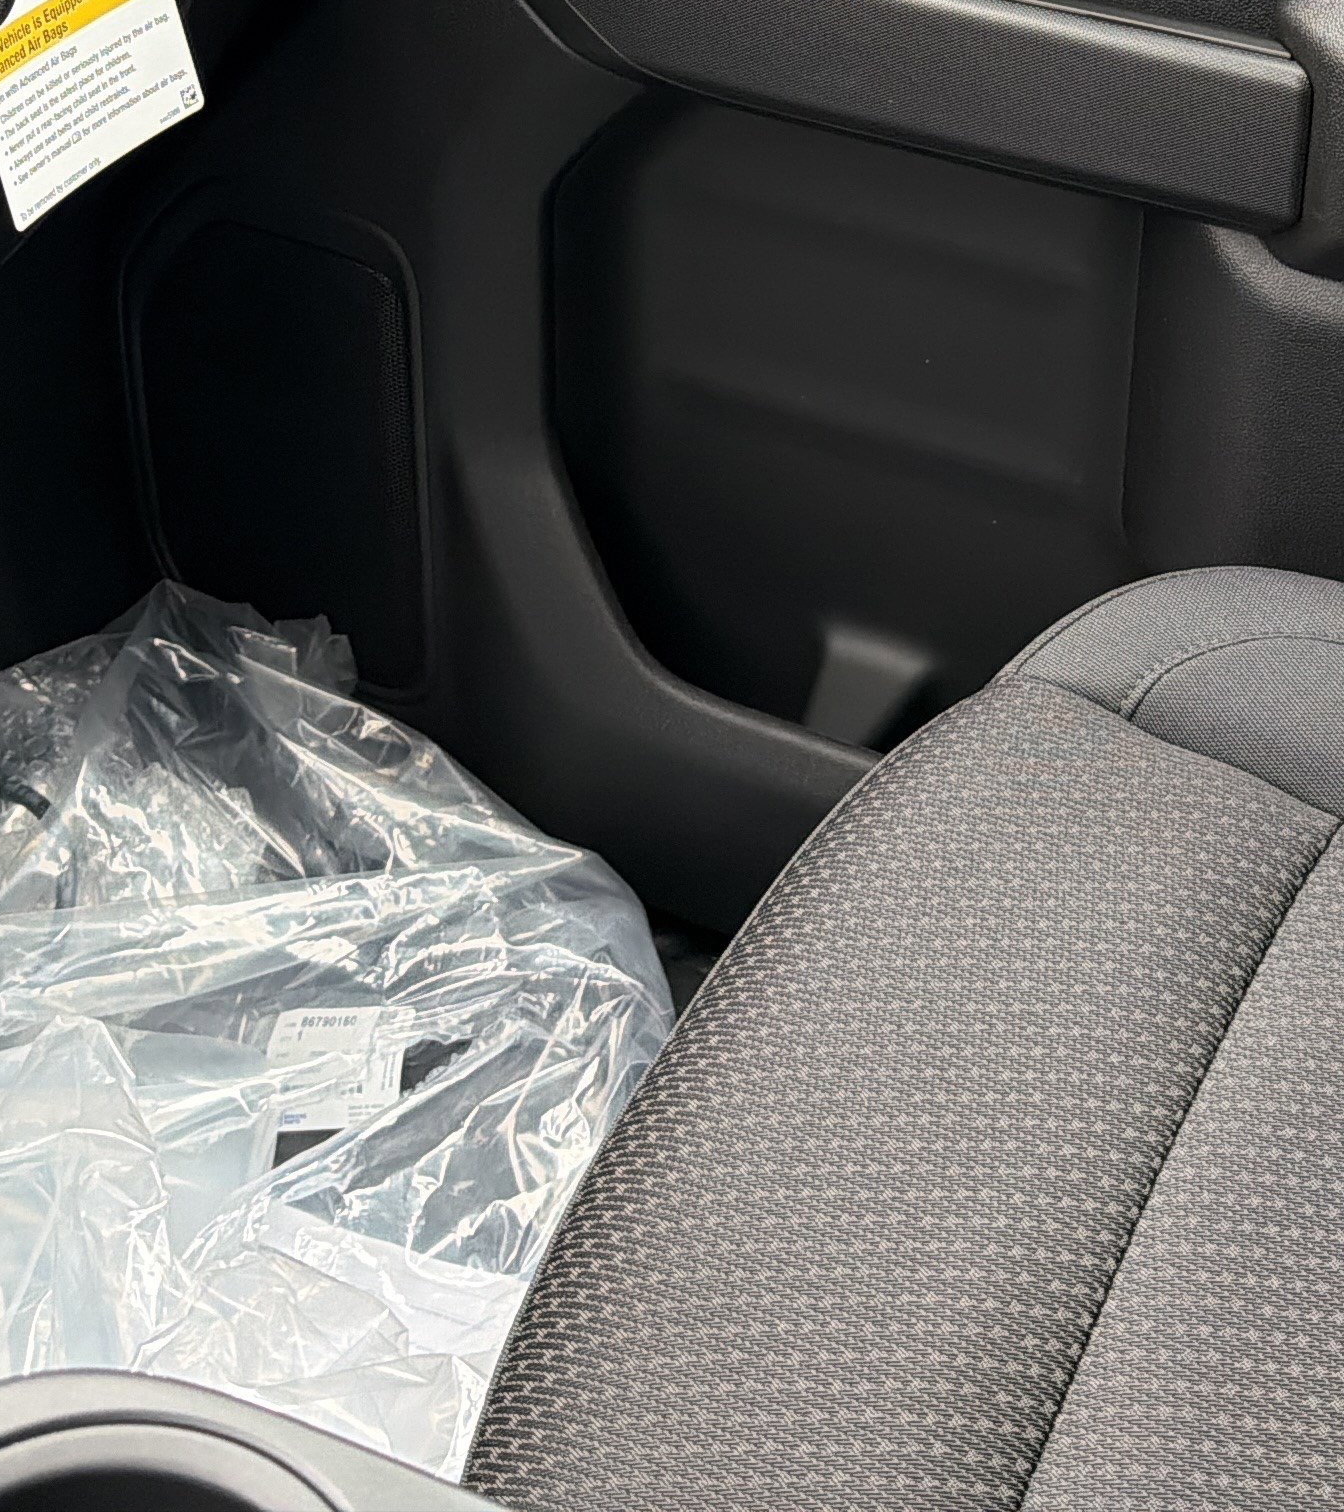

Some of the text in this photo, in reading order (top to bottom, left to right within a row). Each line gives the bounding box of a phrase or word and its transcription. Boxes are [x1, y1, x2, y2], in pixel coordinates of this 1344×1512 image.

[32, 16, 43, 30] is
[27, 36, 42, 55] Air
[42, 21, 69, 43] Bags
